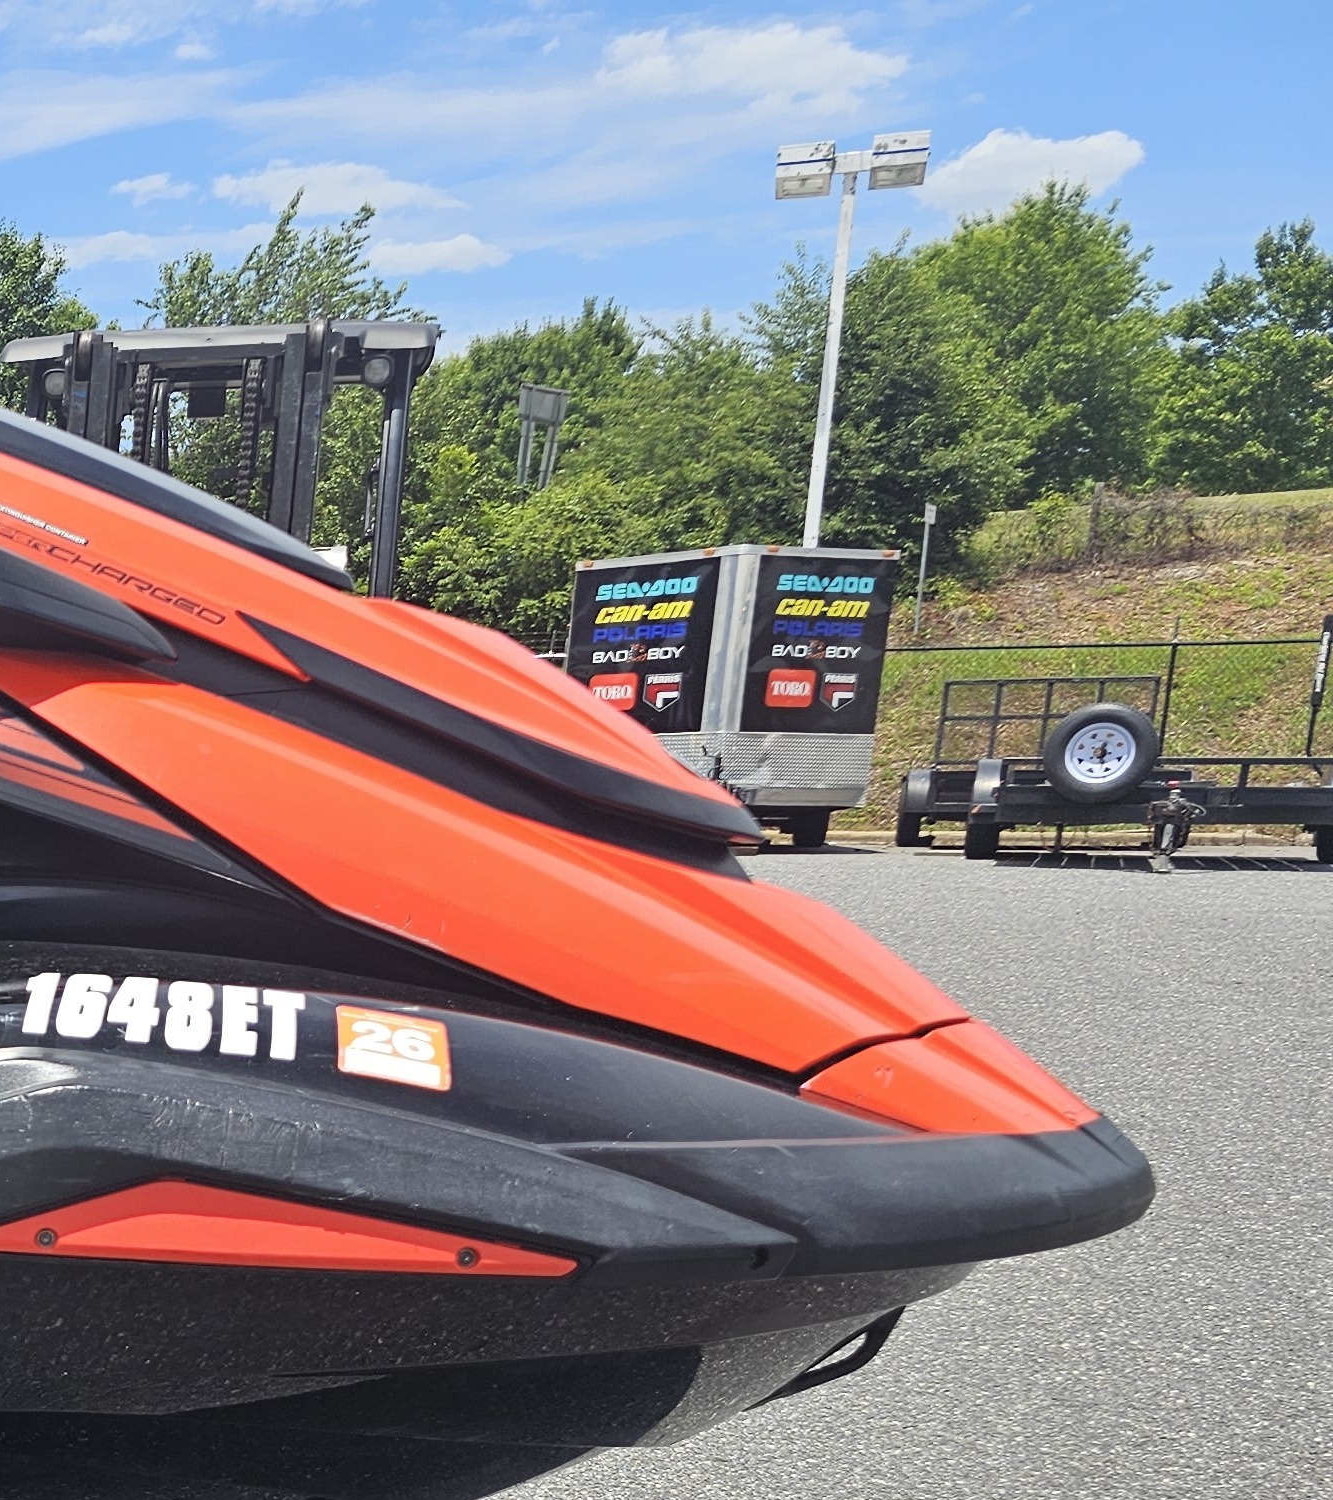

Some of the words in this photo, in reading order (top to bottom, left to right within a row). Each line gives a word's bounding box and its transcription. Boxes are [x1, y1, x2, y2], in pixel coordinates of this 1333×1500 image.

[45, 523, 86, 545] CONTAINER
[592, 622, 687, 644] POLARIS
[773, 620, 865, 638] POLARIS
[592, 649, 628, 664] BAD
[647, 645, 686, 660] BOY
[771, 644, 808, 658] BAD
[825, 646, 862, 659] BOY
[593, 685, 632, 700] TORO
[771, 681, 811, 697] TORO
[21, 972, 306, 1061] 1648ET
[351, 1020, 436, 1061] 26
